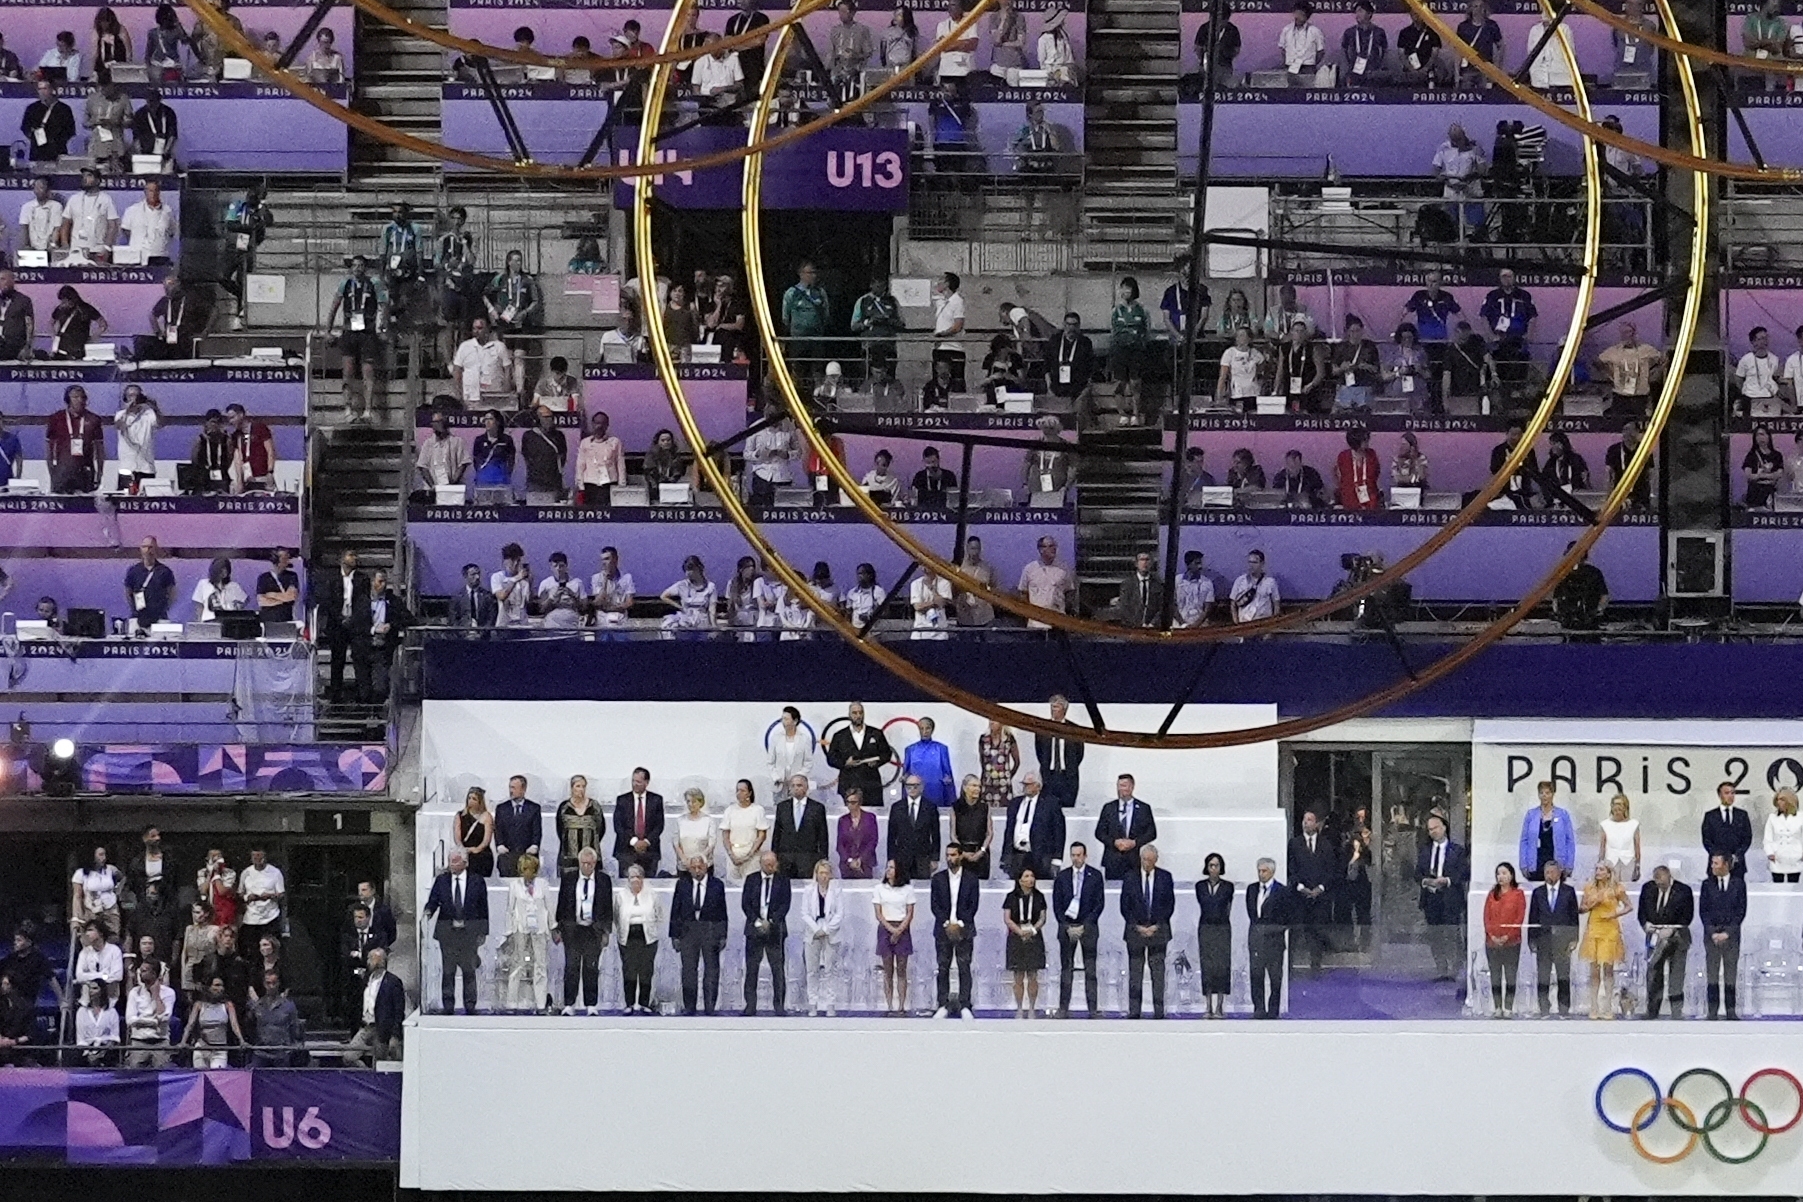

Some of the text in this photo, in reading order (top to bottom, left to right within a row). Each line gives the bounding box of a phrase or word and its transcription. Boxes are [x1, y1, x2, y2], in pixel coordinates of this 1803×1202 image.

[1240, 0, 1271, 10] 2024
[1730, 1, 1761, 12] 2024
[188, 85, 219, 96] 2024
[501, 86, 533, 98] 2024
[997, 89, 1067, 101] PARIS 2024
[1237, 90, 1269, 102] 2024
[1306, 90, 1376, 102] PARIS 2024
[1413, 91, 1483, 102] PARIS 2024
[1625, 91, 1660, 103] PARIS
[1748, 94, 1782, 105] PARIS
[827, 151, 903, 187] U13
[83, 270, 154, 282] PARIS 2024
[1287, 272, 1322, 283] PARIS
[1544, 273, 1576, 285] 2024
[1624, 274, 1658, 286] PARIS
[11, 368, 84, 380] PARIS 2024
[227, 368, 300, 380] PARIS 2024
[585, 366, 617, 378] 2024
[878, 415, 950, 427] PARIS 2024
[988, 415, 1023, 427] PARIS
[1295, 417, 1367, 429] PARIS 2024
[1405, 418, 1477, 430] PARIS 2024
[1558, 418, 1590, 430] 2024
[32, 500, 65, 511] 2024
[144, 499, 176, 511] 2024
[219, 500, 292, 511] PARIS 2024
[427, 508, 499, 520] PARIS 2024
[539, 509, 612, 520] PARIS 2024
[651, 508, 686, 520] PARIS
[763, 509, 835, 521] PARIS 2024
[915, 510, 948, 521] 2024
[986, 510, 1058, 522] PARIS 2024
[1219, 512, 1252, 523] 2024
[1291, 512, 1363, 524] PARIS 2024
[1403, 512, 1438, 524] PARIS
[1512, 512, 1584, 524] PARIS 2024
[1623, 512, 1658, 524] PARIS
[1753, 514, 1788, 526] PARIS
[31, 643, 63, 655] 2024
[104, 644, 177, 656] PARIS 2024
[262, 1106, 332, 1149] U6
